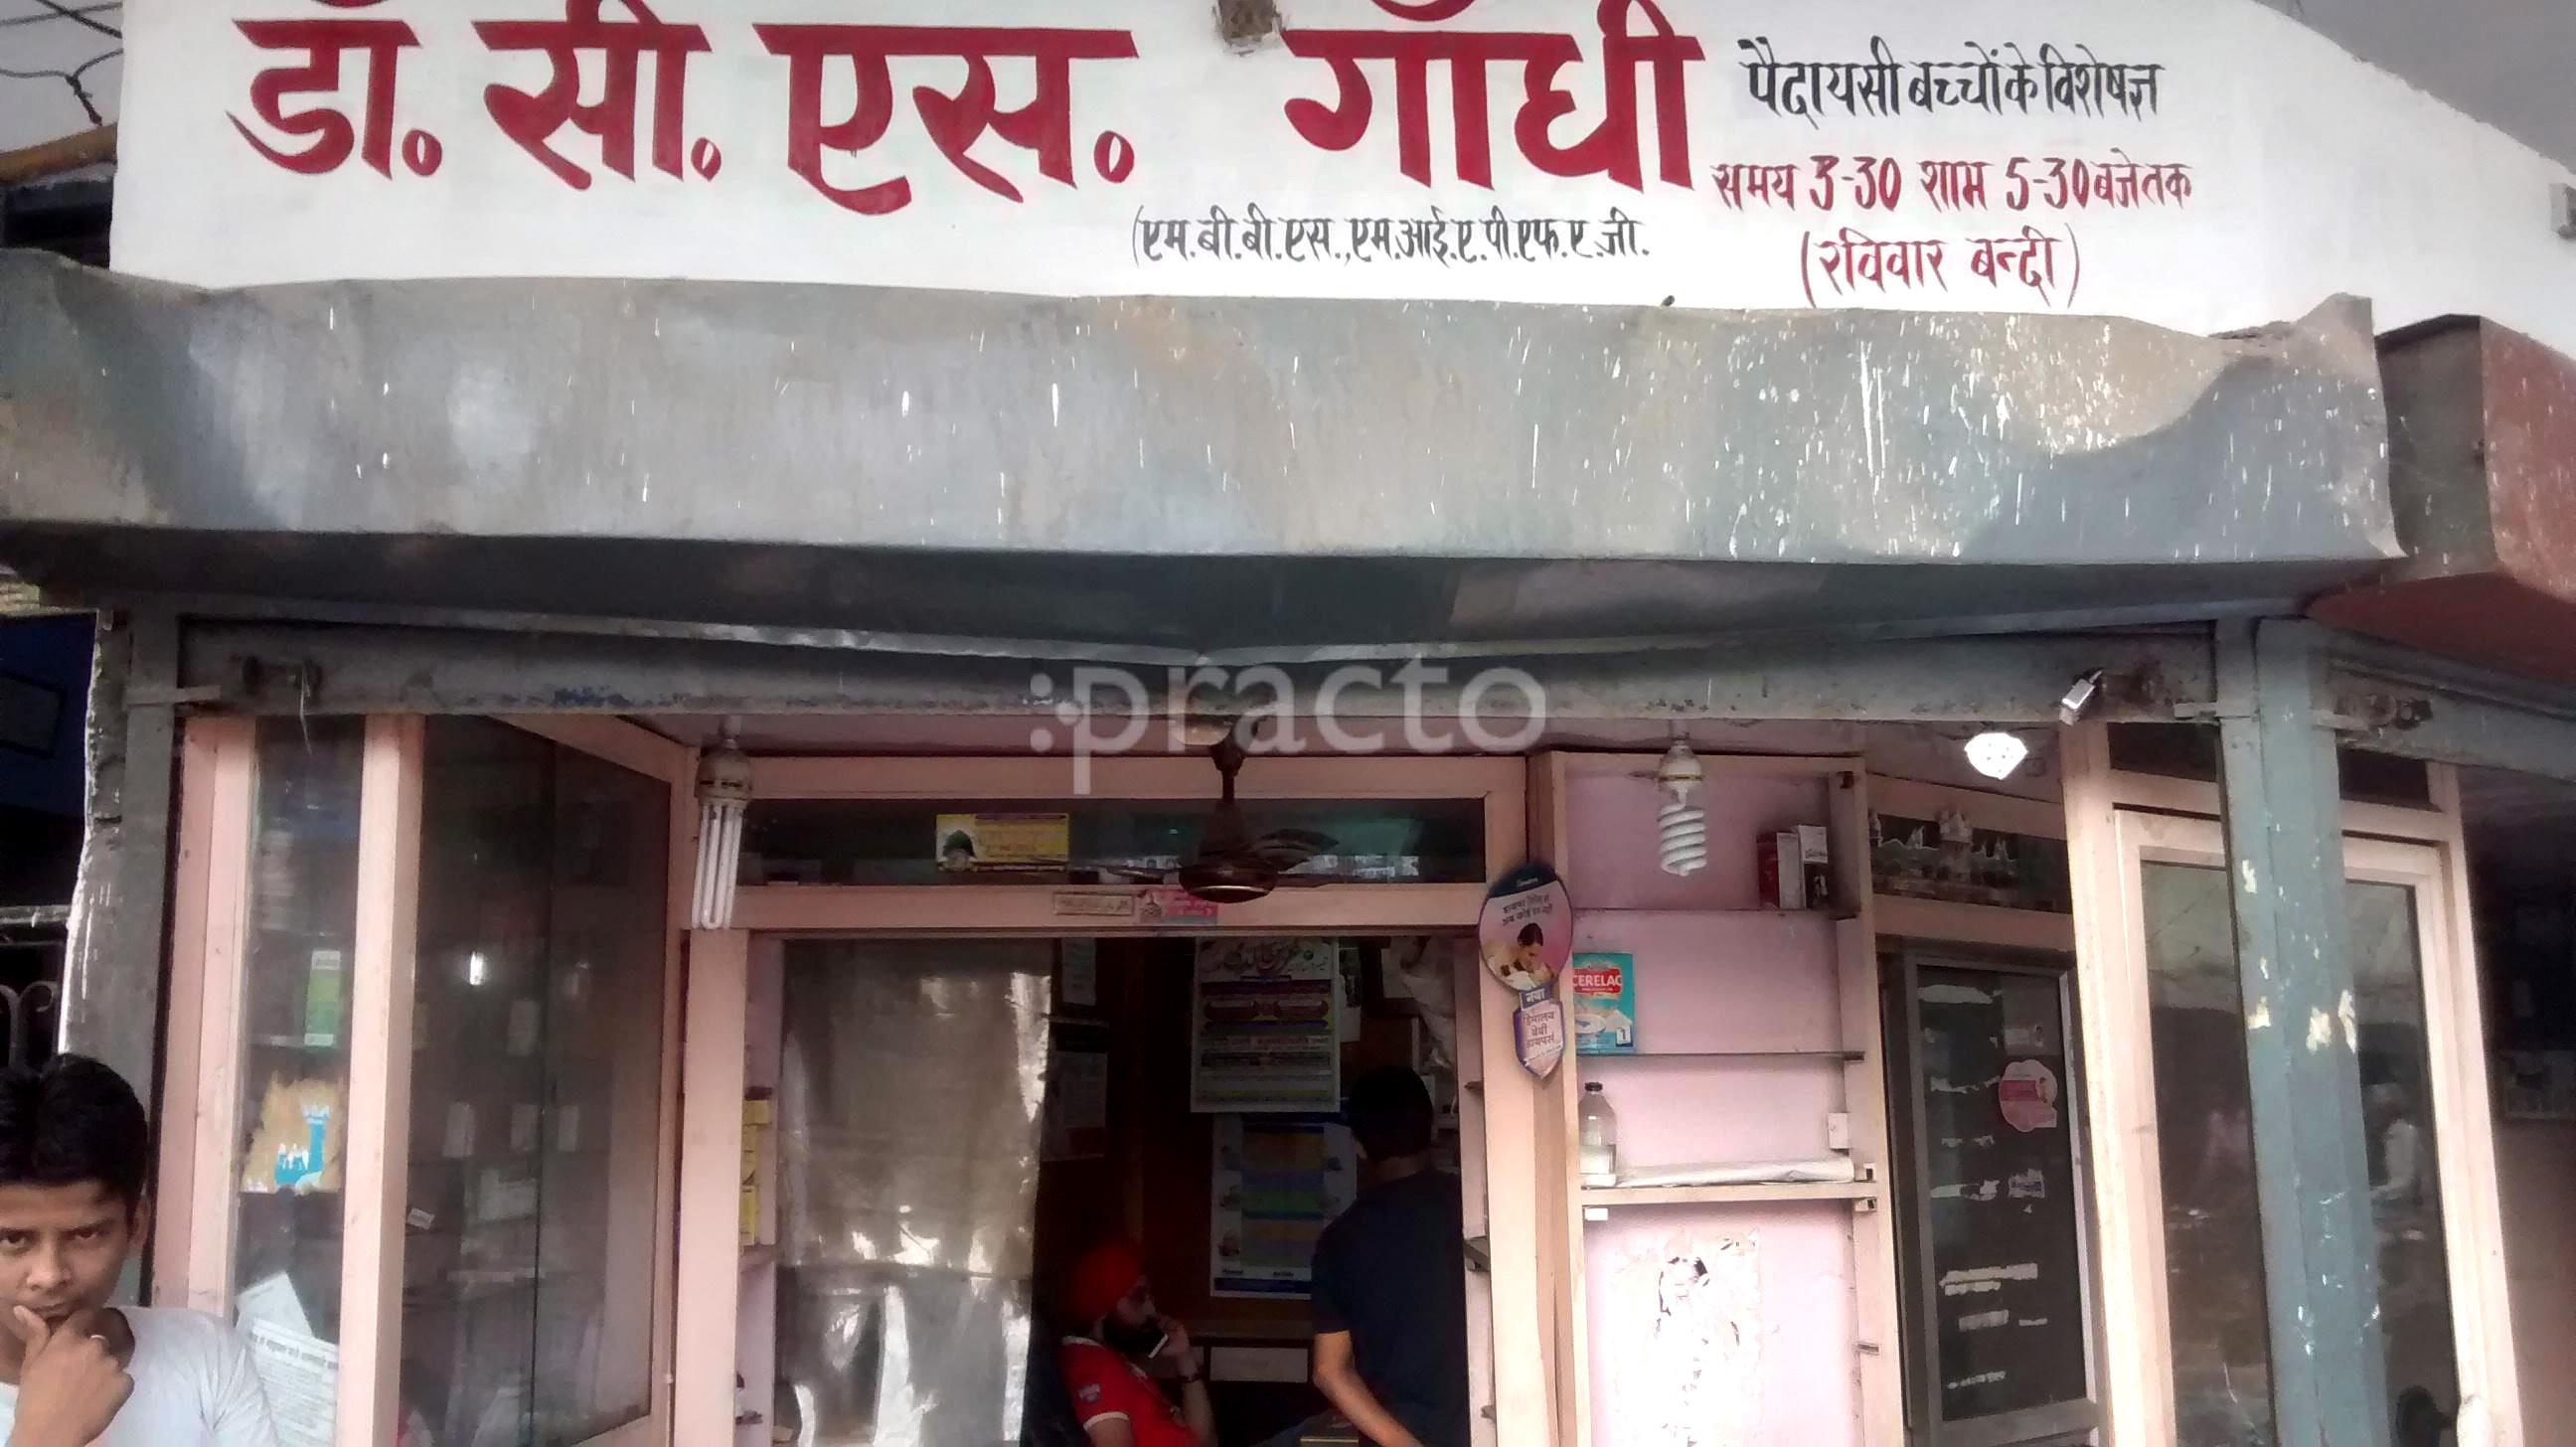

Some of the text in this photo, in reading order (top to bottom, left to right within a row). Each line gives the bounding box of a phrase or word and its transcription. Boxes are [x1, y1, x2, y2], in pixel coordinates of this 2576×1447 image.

[1711, 162, 1802, 212] समय
[1809, 155, 1902, 212] 3-30
[1917, 160, 1991, 212] शाम
[2006, 156, 2090, 211] 5-30
[1572, 974, 1623, 987] CERELAC
